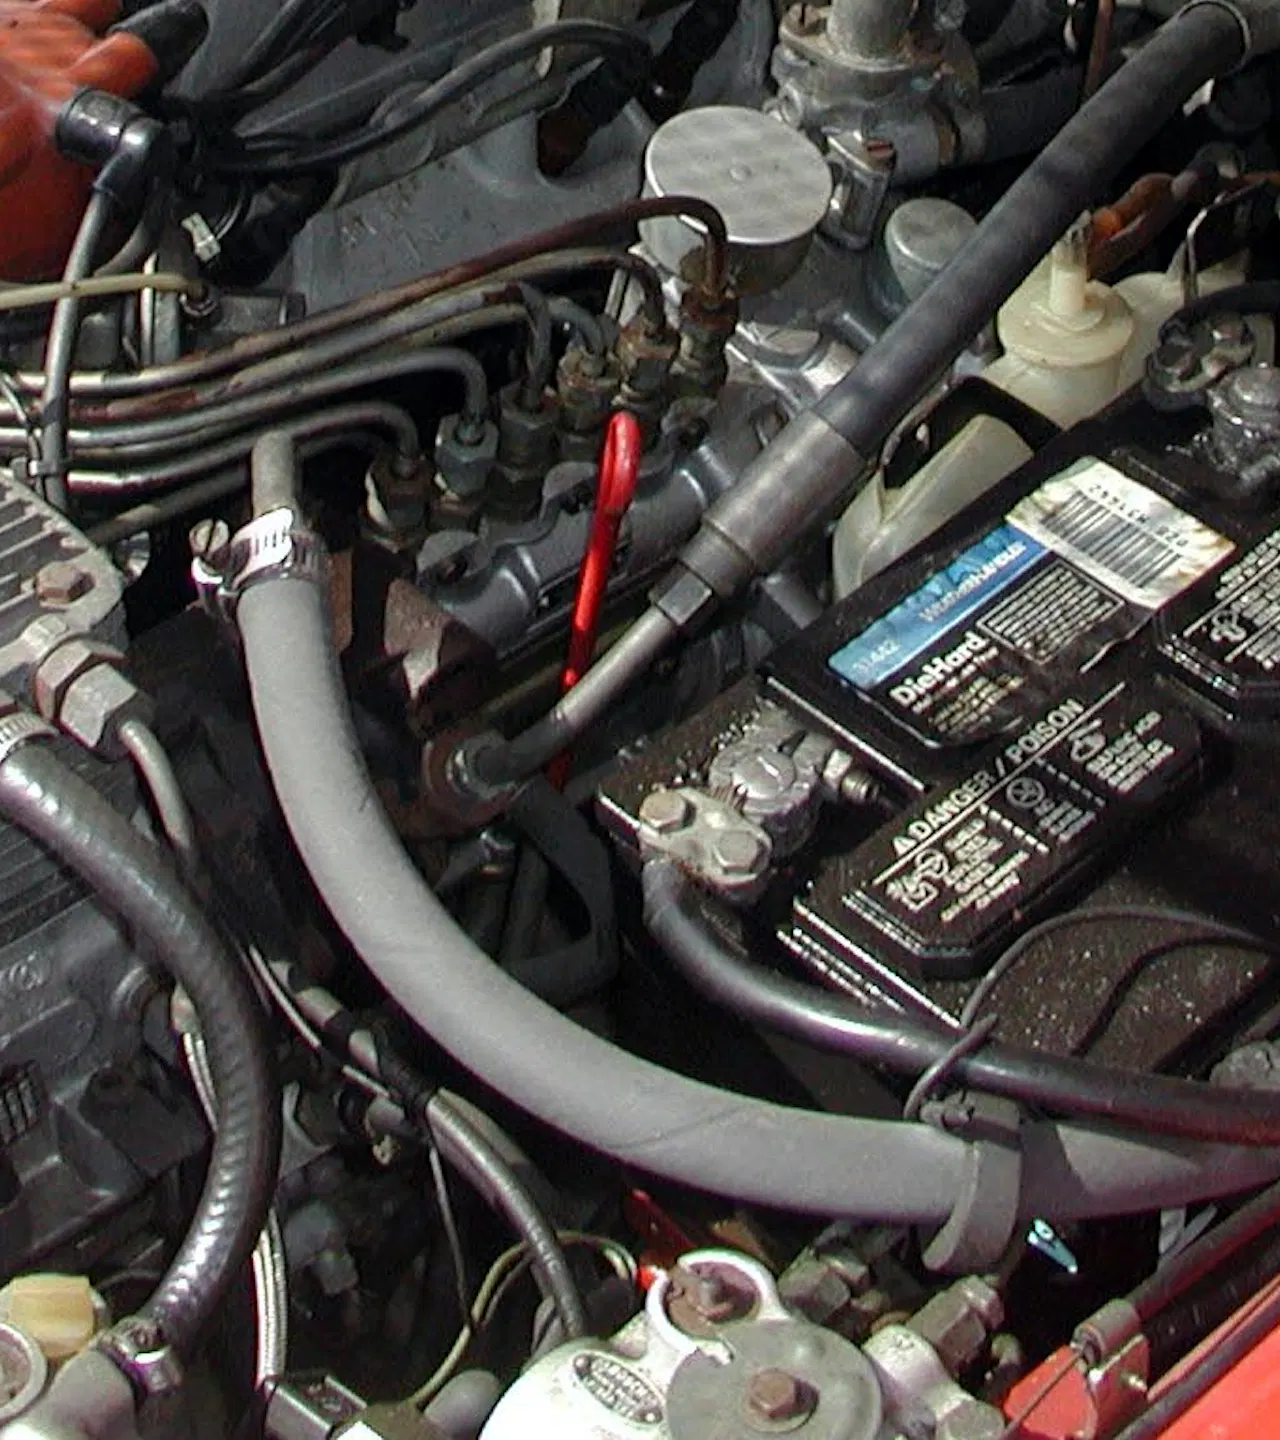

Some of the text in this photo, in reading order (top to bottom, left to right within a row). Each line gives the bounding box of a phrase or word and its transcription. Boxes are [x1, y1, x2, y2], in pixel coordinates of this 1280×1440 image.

[887, 626, 988, 710] DieHard
[908, 767, 996, 843] DANGER
[1003, 695, 1085, 767] POISON
